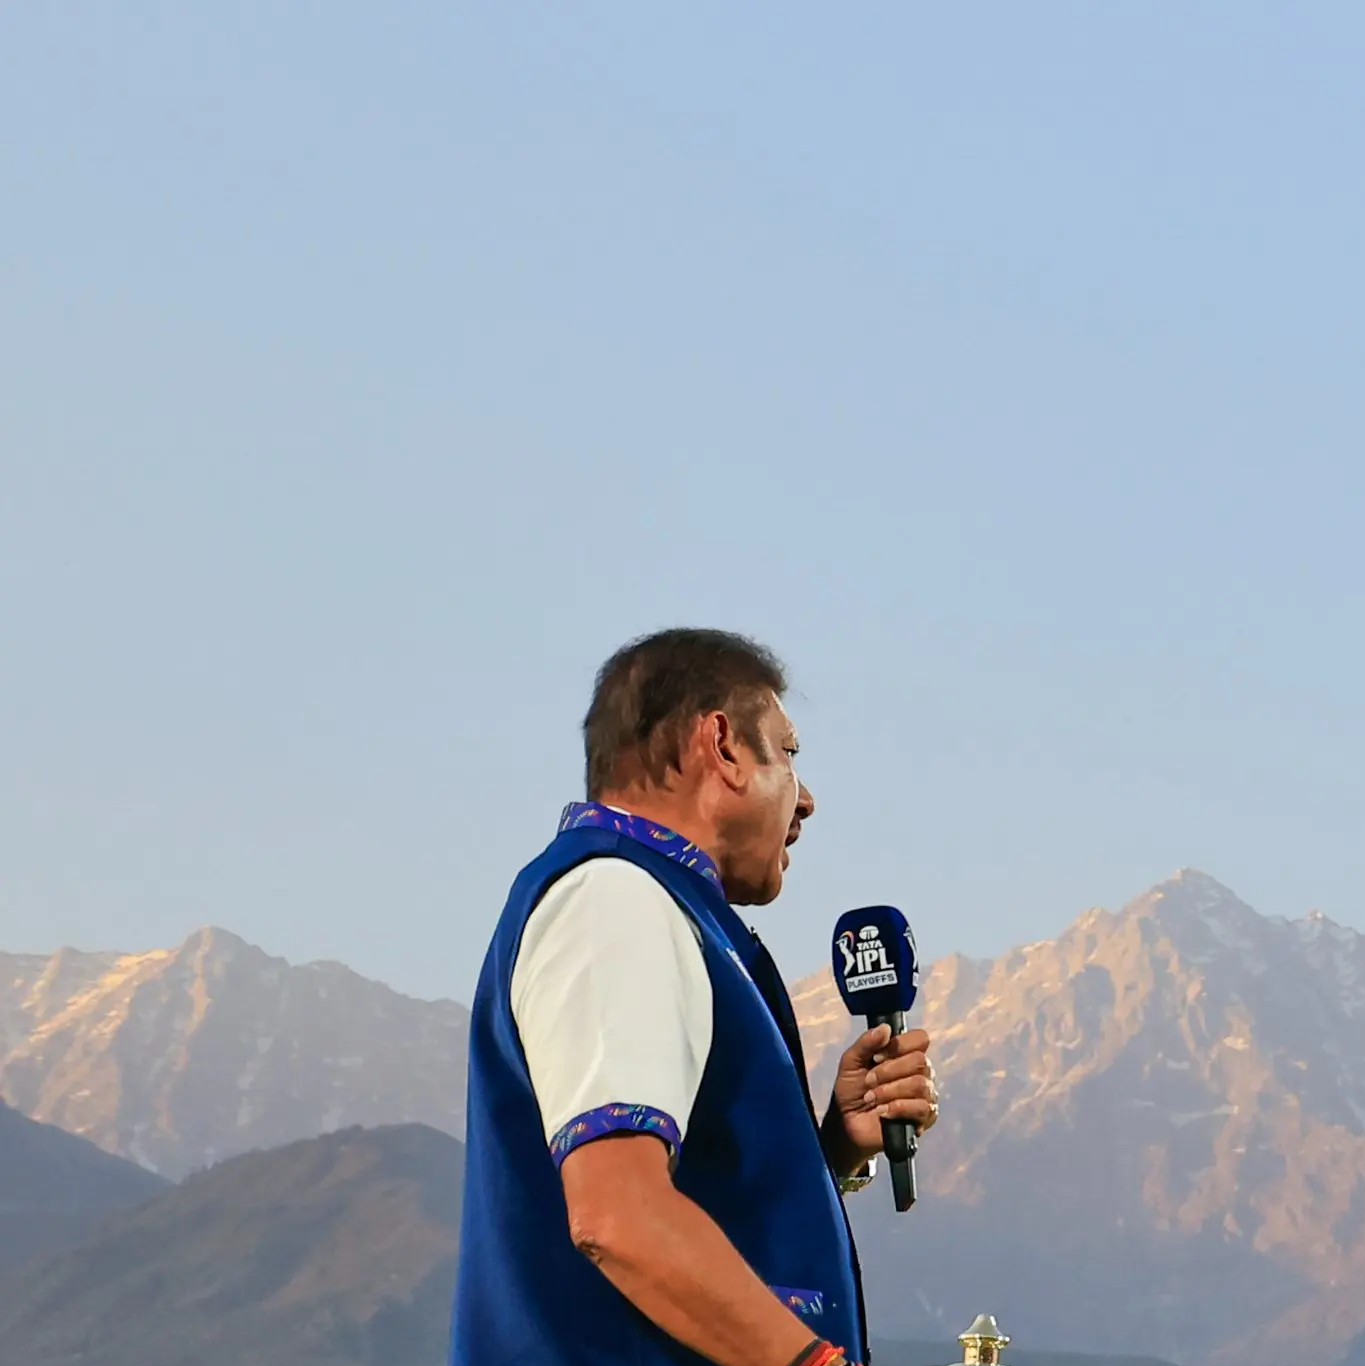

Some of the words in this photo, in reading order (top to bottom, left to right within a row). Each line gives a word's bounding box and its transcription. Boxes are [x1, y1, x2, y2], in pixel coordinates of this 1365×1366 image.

[856, 941, 883, 950] TATA
[855, 948, 895, 974] IPL
[848, 974, 895, 989] PLAYOFFS
